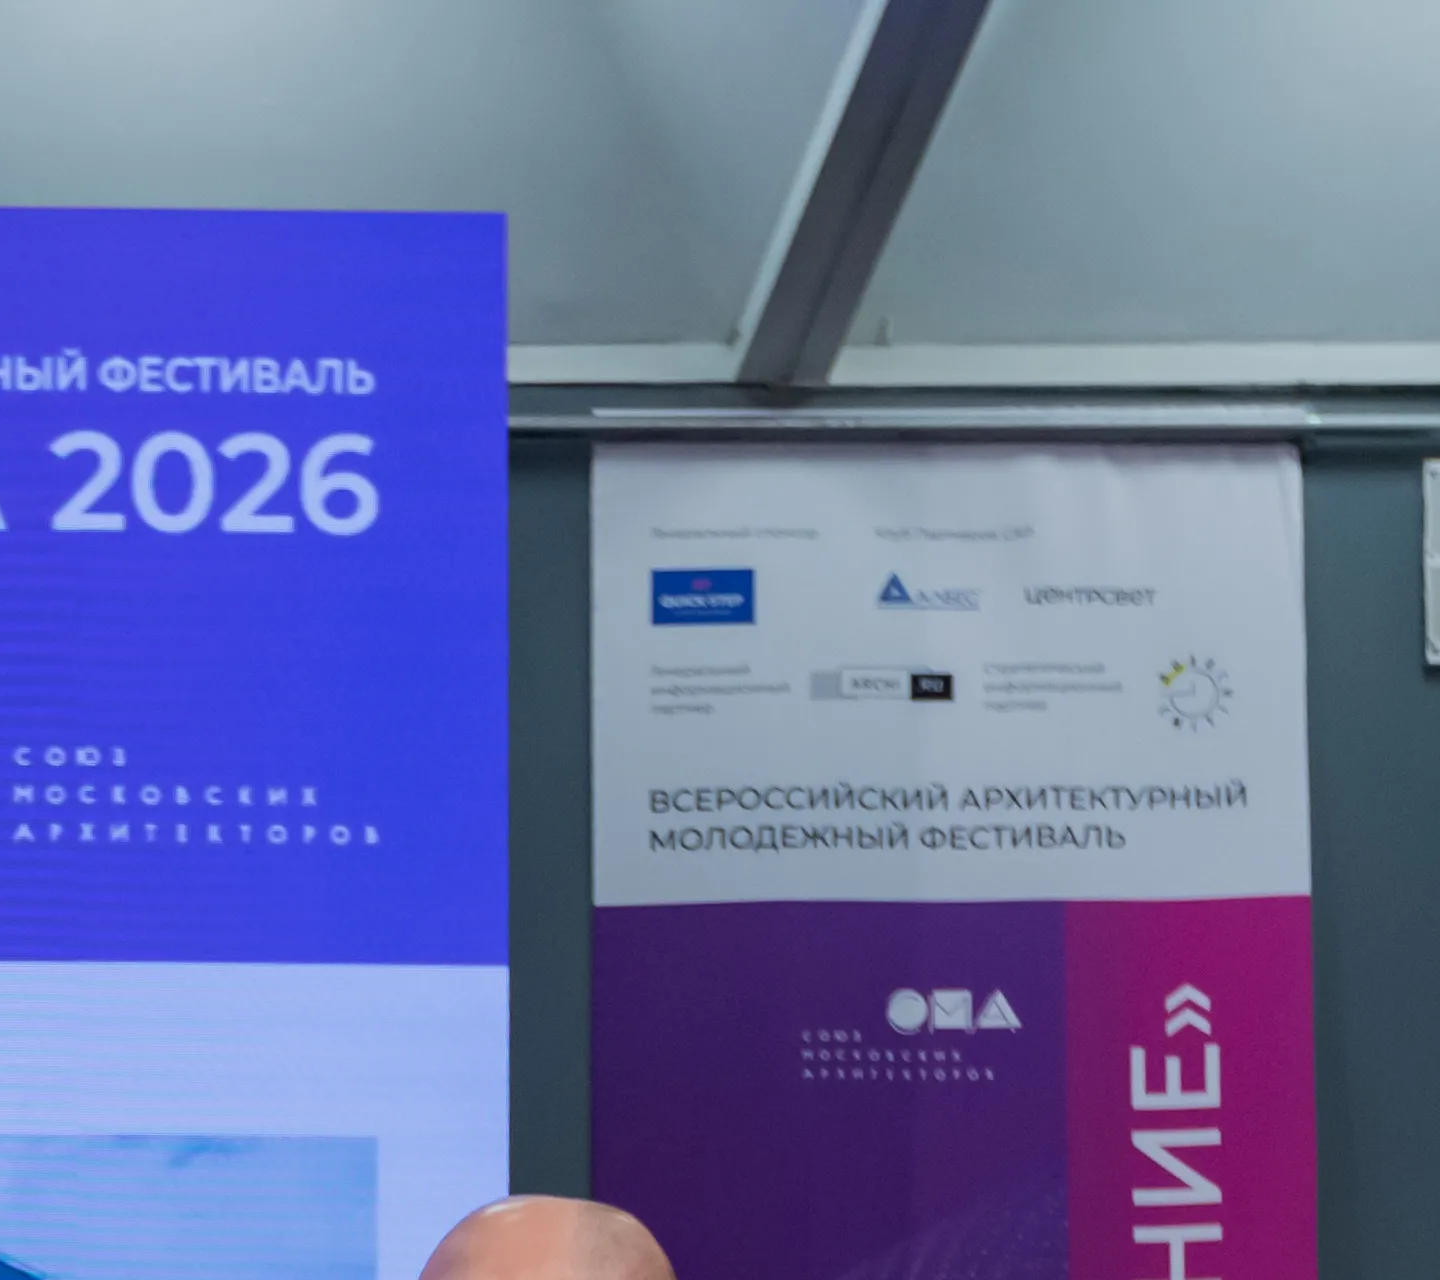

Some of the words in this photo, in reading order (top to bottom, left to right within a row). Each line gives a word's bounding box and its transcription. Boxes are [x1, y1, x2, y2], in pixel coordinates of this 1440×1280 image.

[98, 354, 376, 396] ФЕСТИВАЛЬ
[49, 430, 380, 537] 2026
[13, 746, 127, 767] СОЮЗ
[13, 784, 317, 806] МОСКОВСКИХ
[649, 782, 948, 814] ВСЕРОССИЙСКИЙ
[960, 779, 1248, 811] АРХИТЕКТУРНЫЙ
[13, 822, 380, 846] АРХИТЕКТОРОВ
[649, 821, 909, 853] МОЛОДЕЖНЫЙ
[918, 824, 1126, 851] ФЕСТИВАЛЬ
